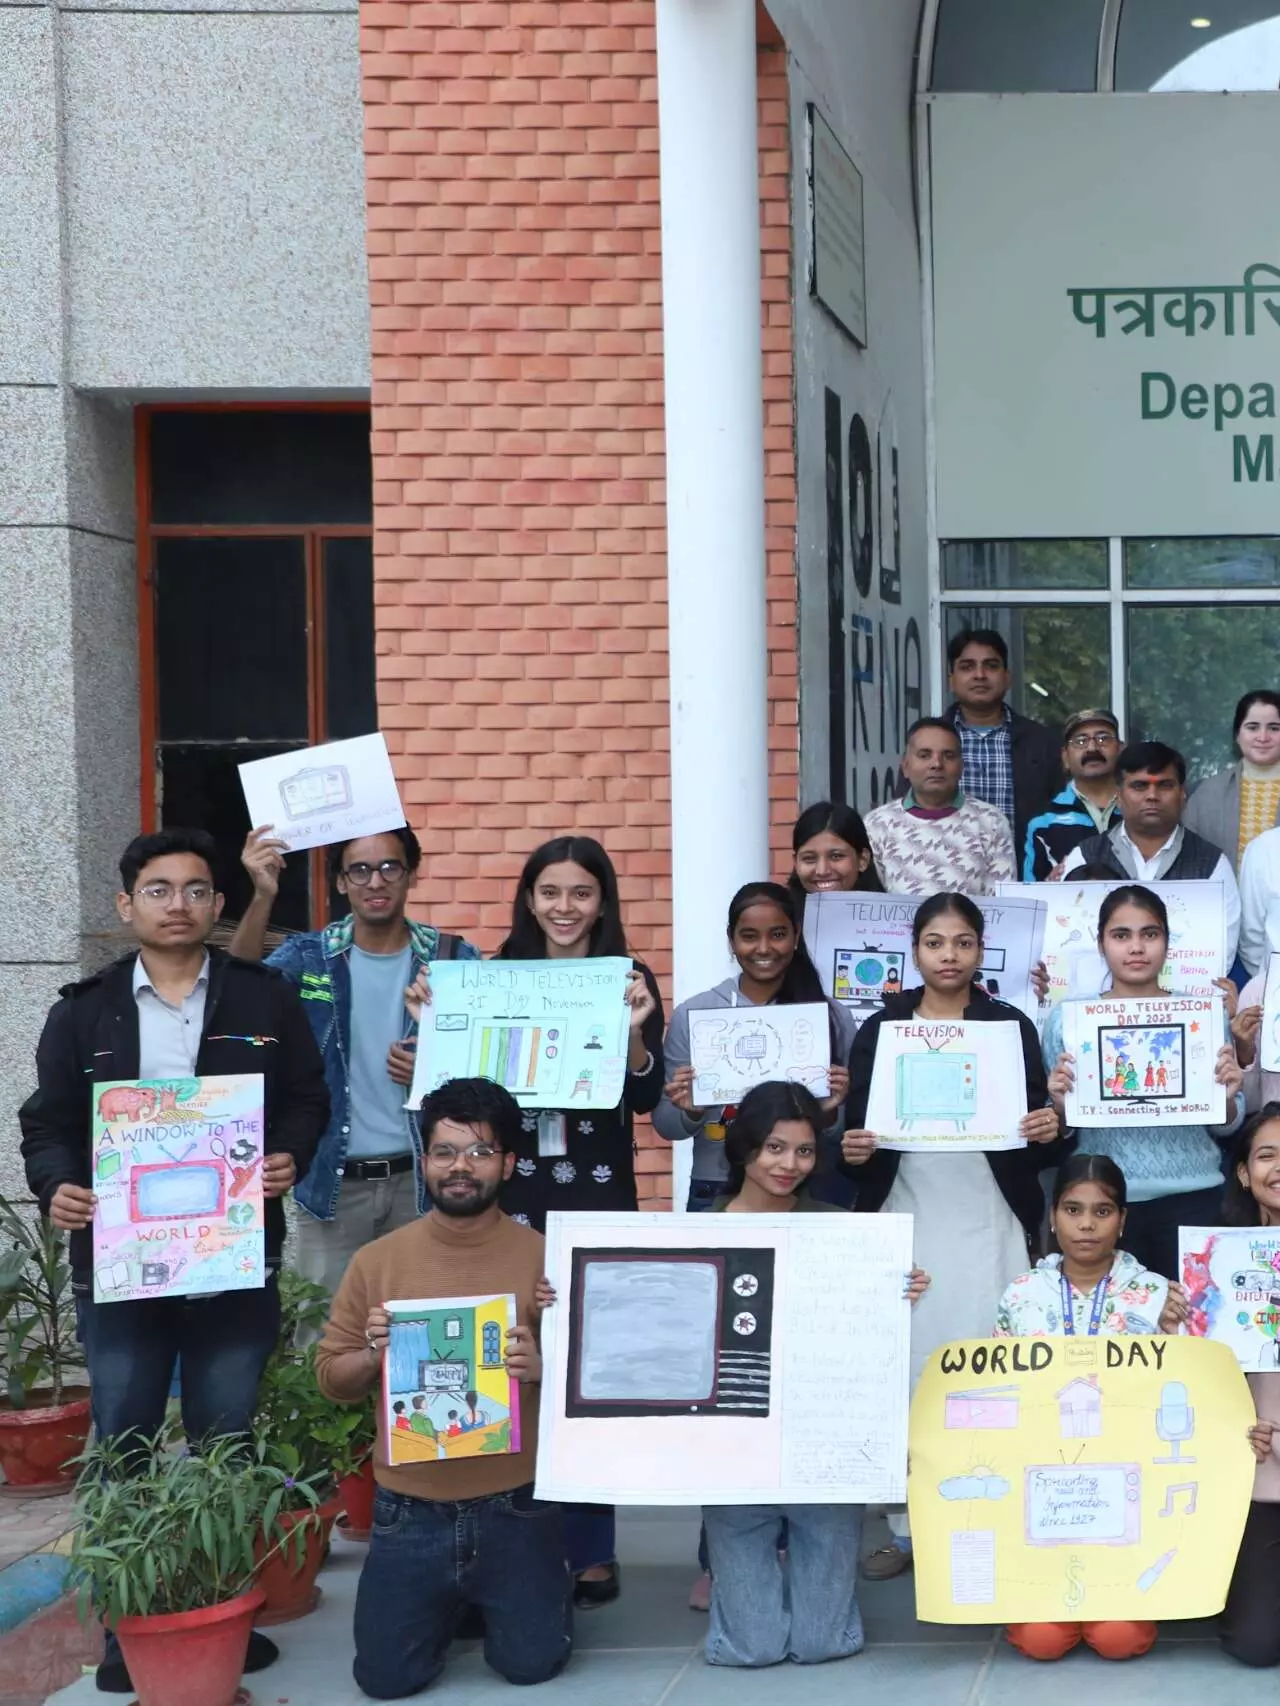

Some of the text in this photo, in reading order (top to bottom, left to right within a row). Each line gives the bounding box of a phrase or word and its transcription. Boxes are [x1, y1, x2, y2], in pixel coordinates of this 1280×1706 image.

[461, 964, 618, 990] WORLD TELEVISION
[1085, 1000, 1212, 1015] WORLD TELEVISION
[1118, 1013, 1173, 1026] DAY 2025
[894, 1024, 964, 1038] TELEVISION
[1108, 1104, 1161, 1117] Connecting
[1164, 1104, 1179, 1113] the
[1181, 1103, 1211, 1113] WORLD
[99, 1120, 260, 1145] A WINDOW TO THE
[136, 1224, 211, 1243] WORLD
[940, 1341, 1053, 1375] WORLD
[1106, 1340, 1167, 1369] DAY
